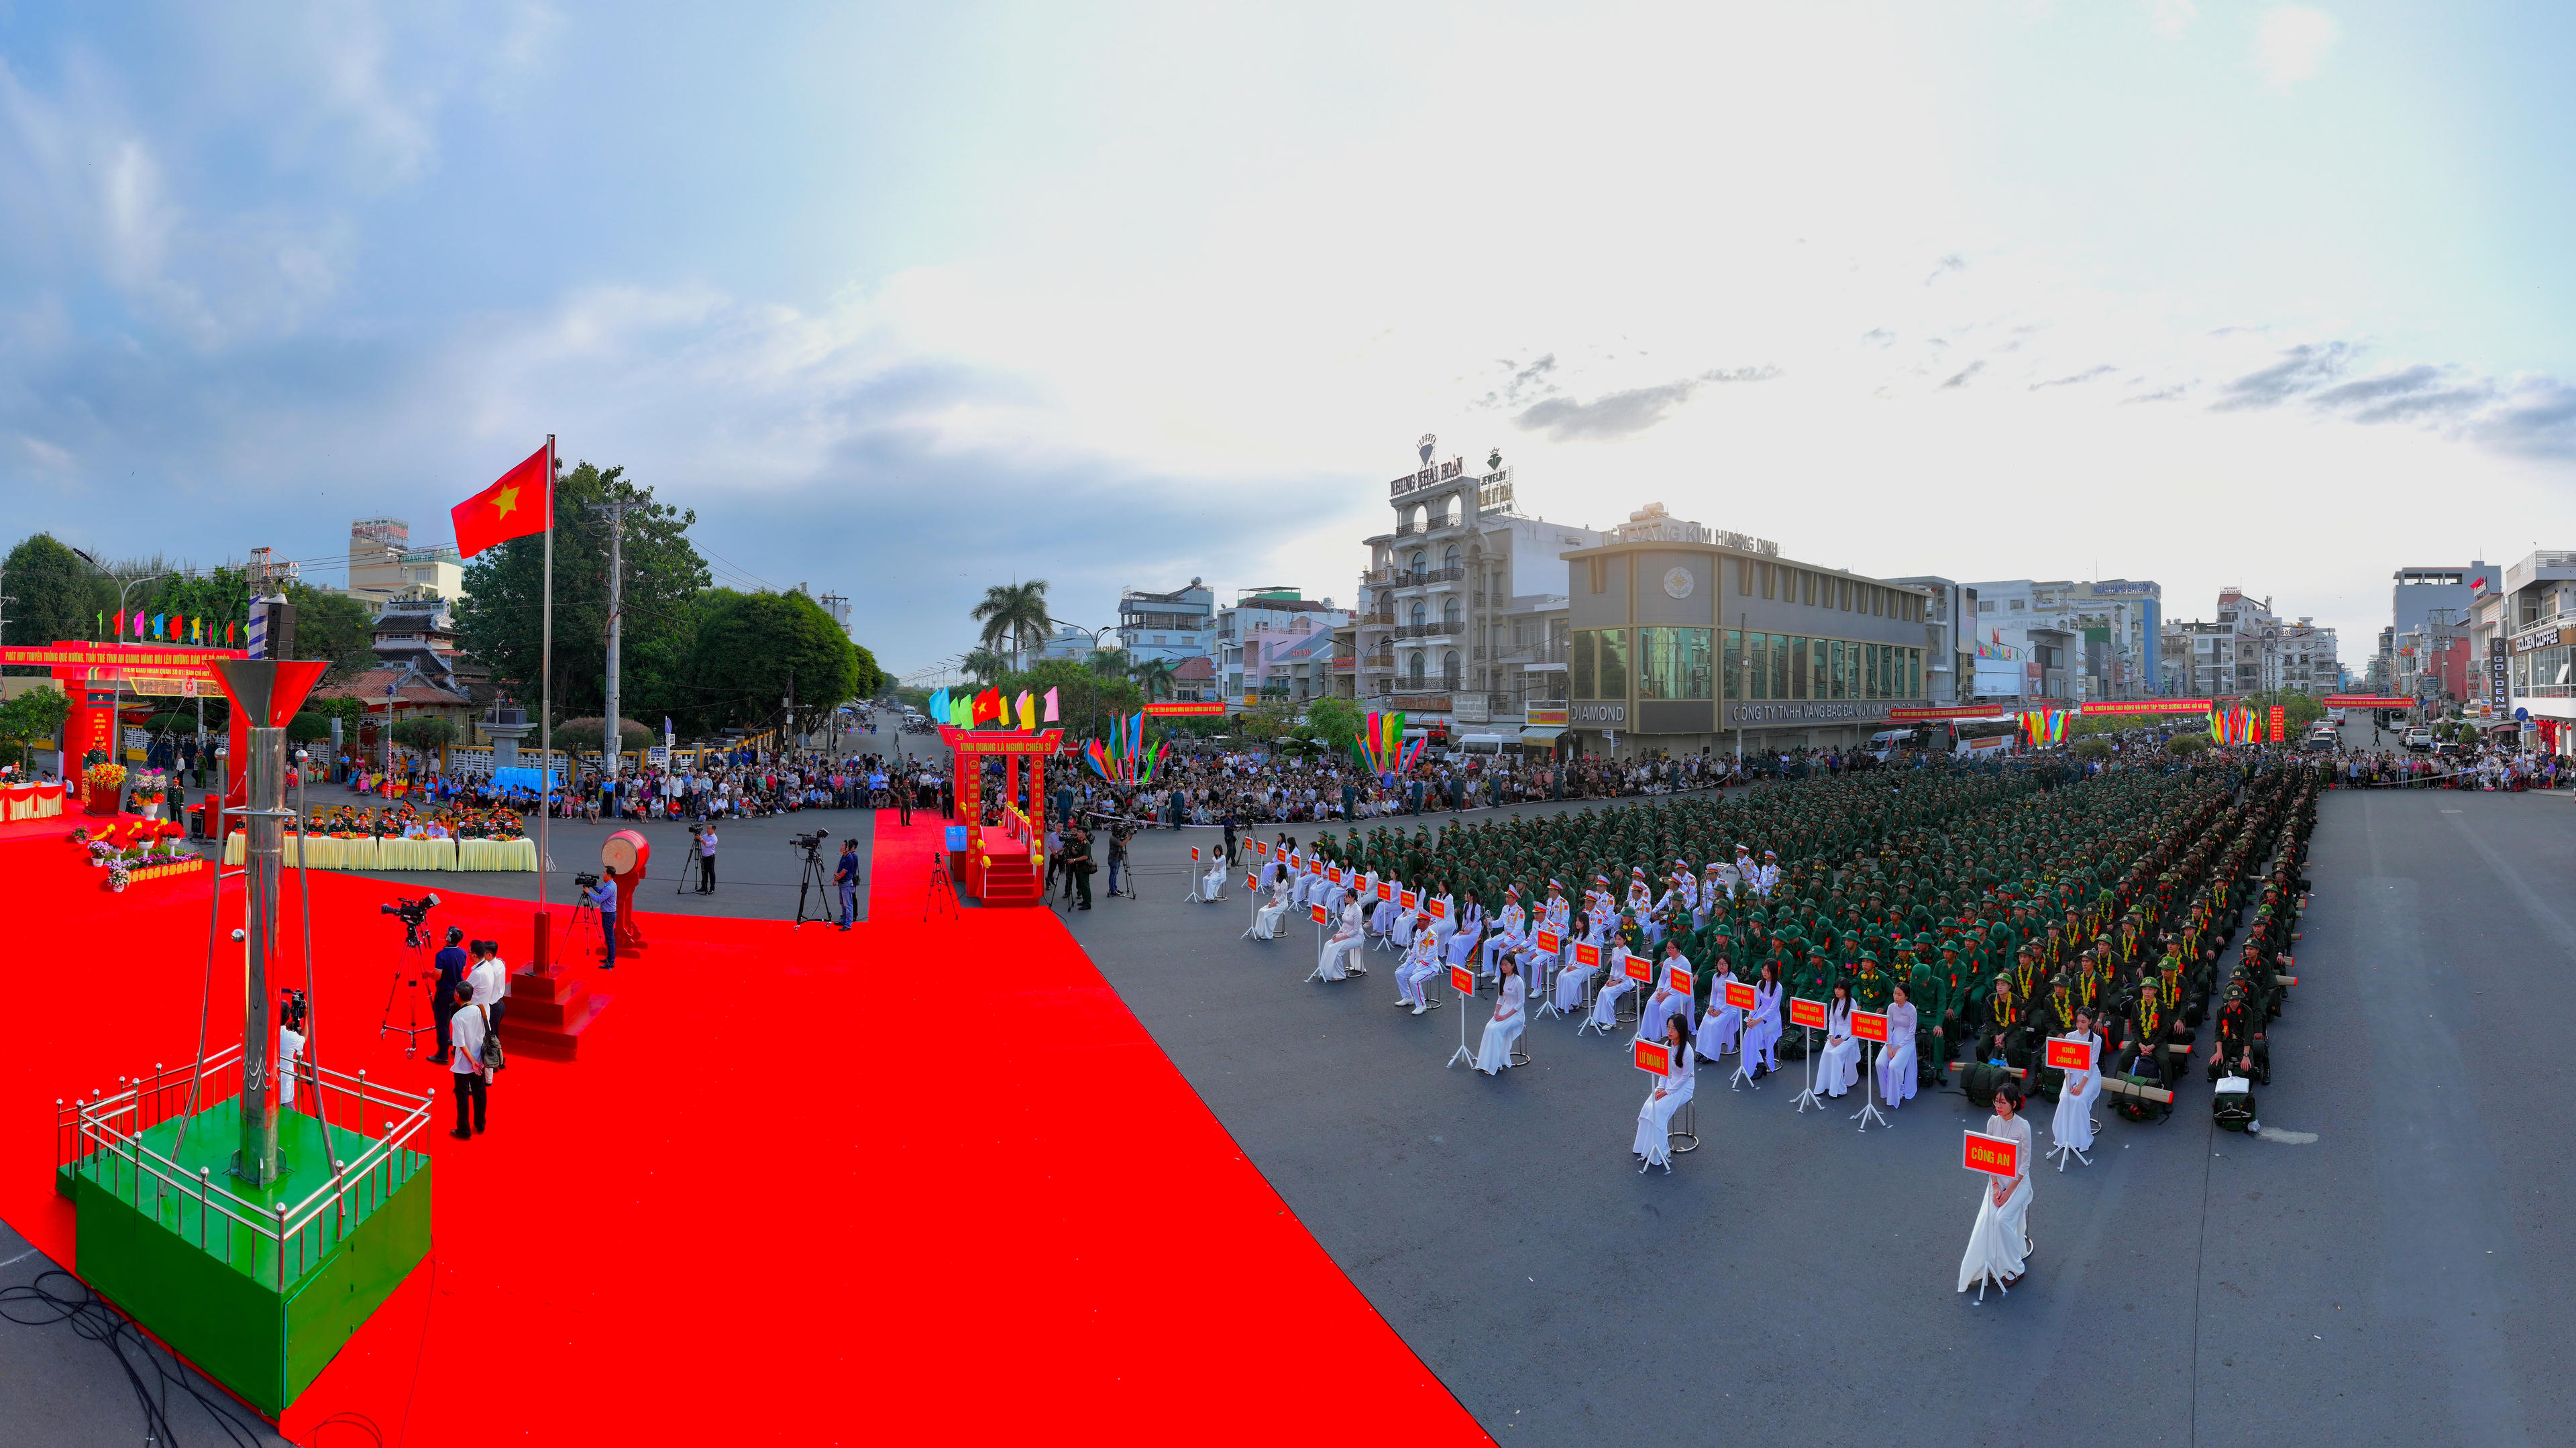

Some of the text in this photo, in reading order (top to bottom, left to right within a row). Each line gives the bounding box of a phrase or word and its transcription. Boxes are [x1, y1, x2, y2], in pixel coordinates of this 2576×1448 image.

[1390, 453, 1463, 496] NHUNG KHẢI HOÀN
[1481, 470, 1507, 486] JEWELRY
[1601, 528, 1627, 547] TIỆM
[1686, 526, 1712, 543] KIM
[1715, 529, 1754, 551] HƯƠNG
[402, 554, 422, 562] THANH
[2093, 583, 2109, 594] NGÂN
[2110, 583, 2126, 593] HÀNG
[2127, 581, 2137, 592] SÀI
[2138, 581, 2151, 592] GÒN
[2516, 628, 2559, 652] GOLDEN COFFEE
[5, 649, 16, 661] PHÁT
[17, 652, 25, 661] HUY
[27, 649, 42, 662] TRUYỀN
[118, 654, 124, 663] AN
[125, 654, 140, 664] GIANG
[2493, 656, 2505, 703] GOLDEN
[1572, 706, 1624, 722] DIAMOND
[1733, 702, 1883, 721] CÔNG TY TNHH VÀNG BẠC ĐÁ QUÝ KIM
[961, 742, 975, 751] VINH
[976, 743, 996, 753] QUANG
[998, 741, 1005, 752] LÀ
[1006, 741, 1024, 752] NGƯỜI
[1026, 740, 1043, 751] CHIẾN
[1731, 987, 1741, 995] THANH
[1810, 1005, 1819, 1013] NIÊN
[1858, 1016, 1881, 1026] THANH NIÊN
[2061, 1045, 2076, 1054] KHỐI
[1661, 1057, 1665, 1070] 6
[2056, 1055, 2072, 1064] CÔNG
[1971, 1146, 2010, 1167] CÔNG AN
